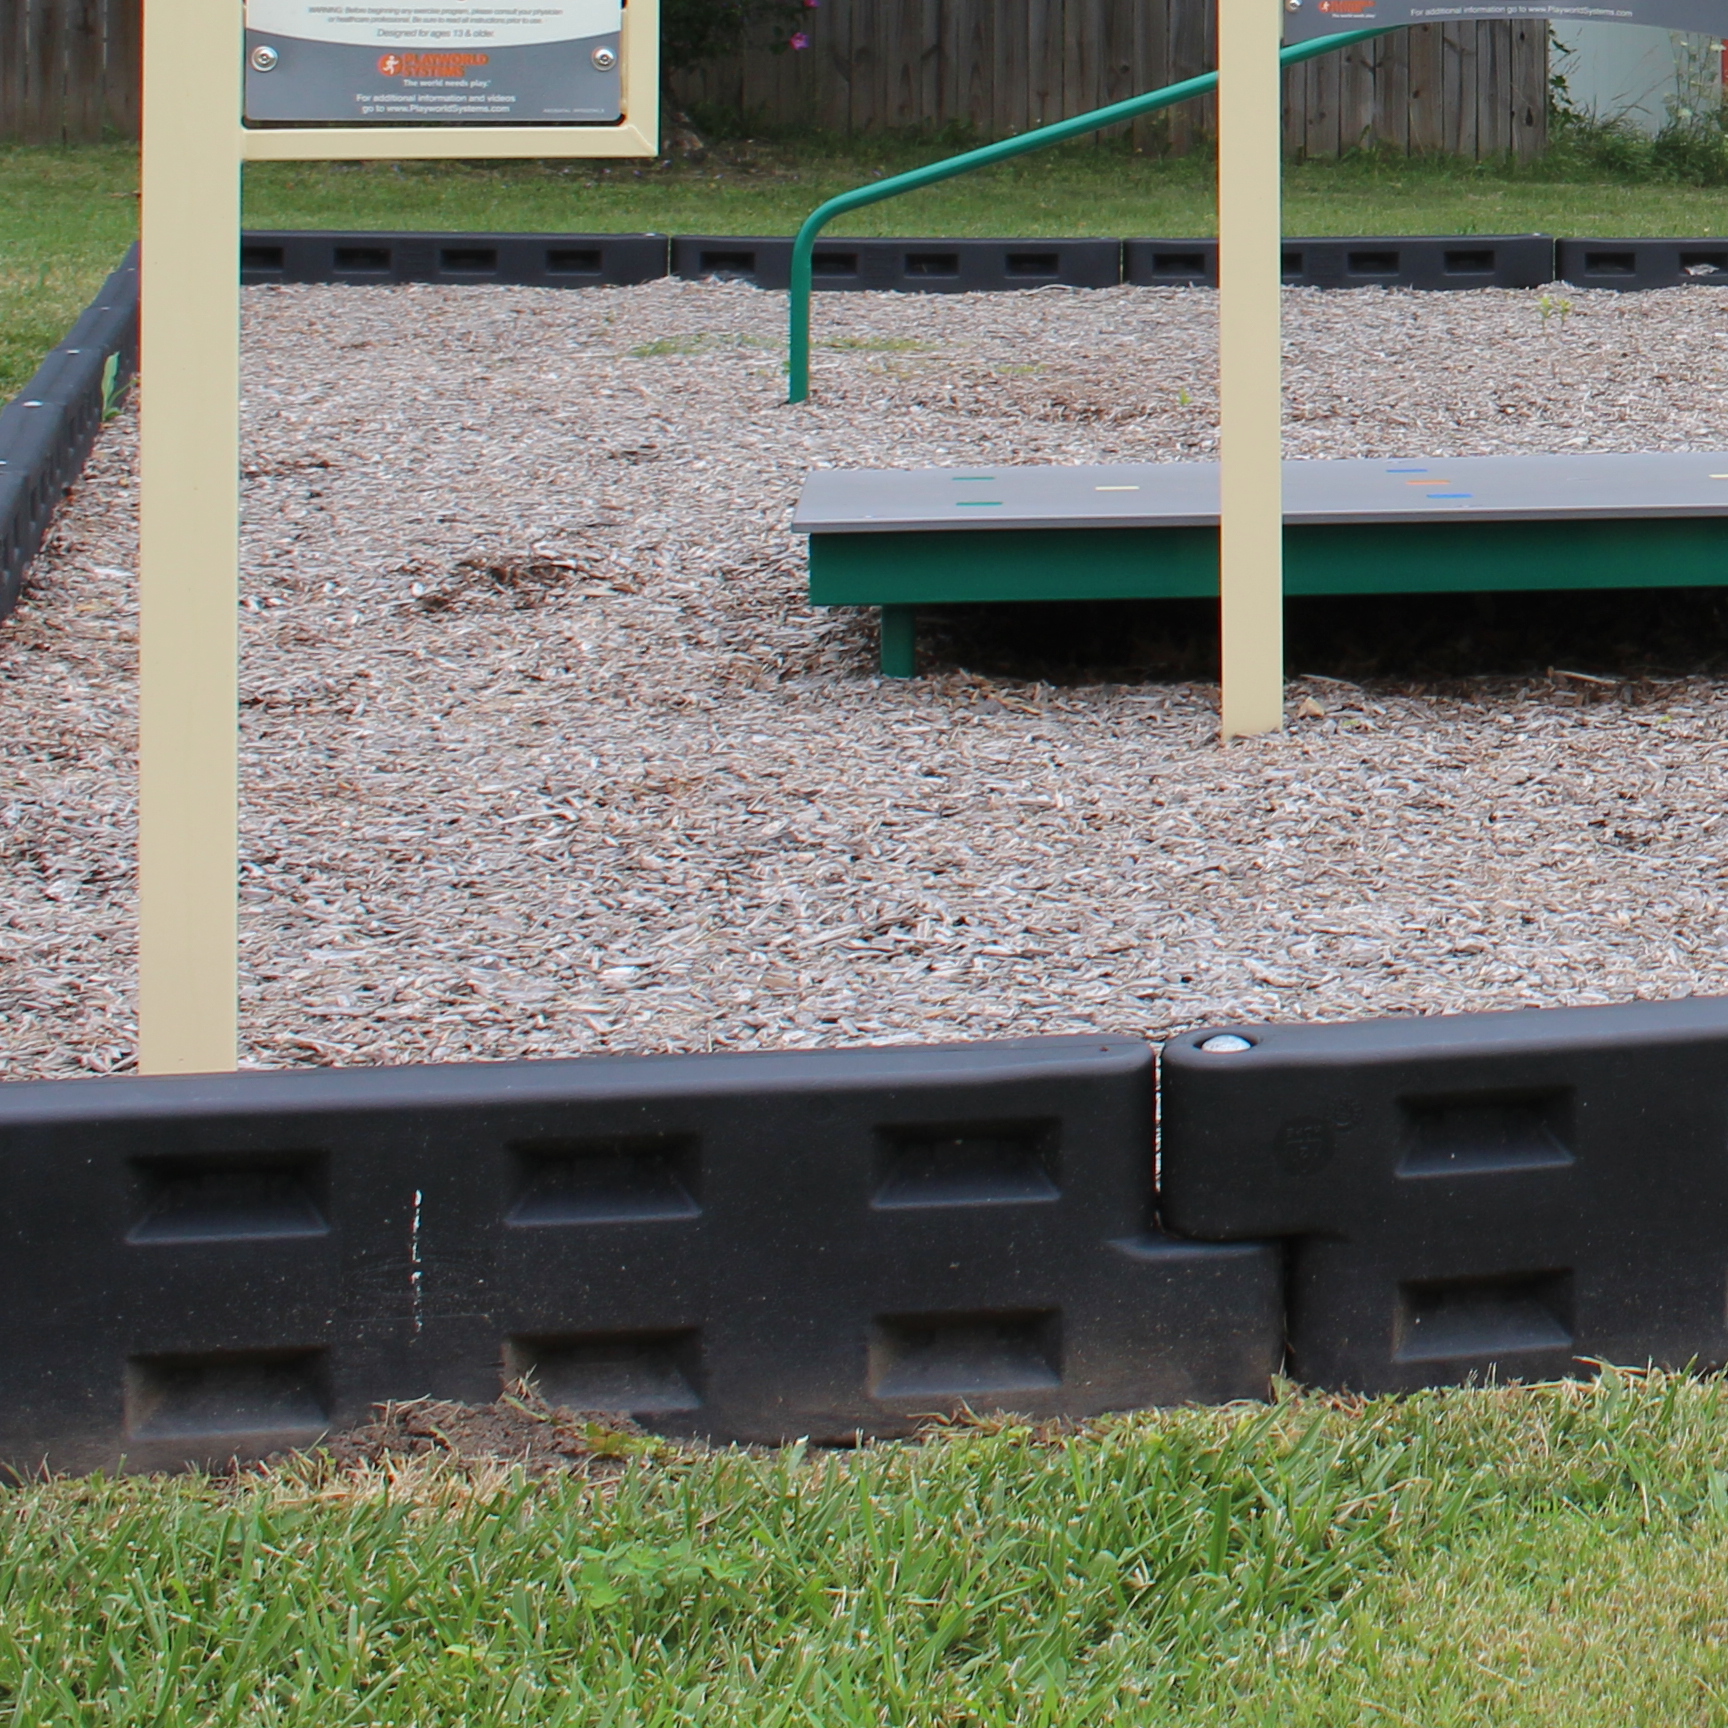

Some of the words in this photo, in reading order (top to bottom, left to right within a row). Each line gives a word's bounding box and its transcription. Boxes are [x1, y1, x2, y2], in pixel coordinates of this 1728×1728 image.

[402, 53, 490, 66] PLAYWORLD
[402, 66, 466, 77] SYSTEMS
[356, 94, 372, 103] For
[373, 94, 416, 103] additional
[418, 94, 467, 103] information
[468, 94, 486, 103] and
[487, 94, 516, 103] videos
[362, 105, 374, 114] go
[376, 105, 385, 113] to
[386, 104, 510, 115] www.PlayworldSystems.com
